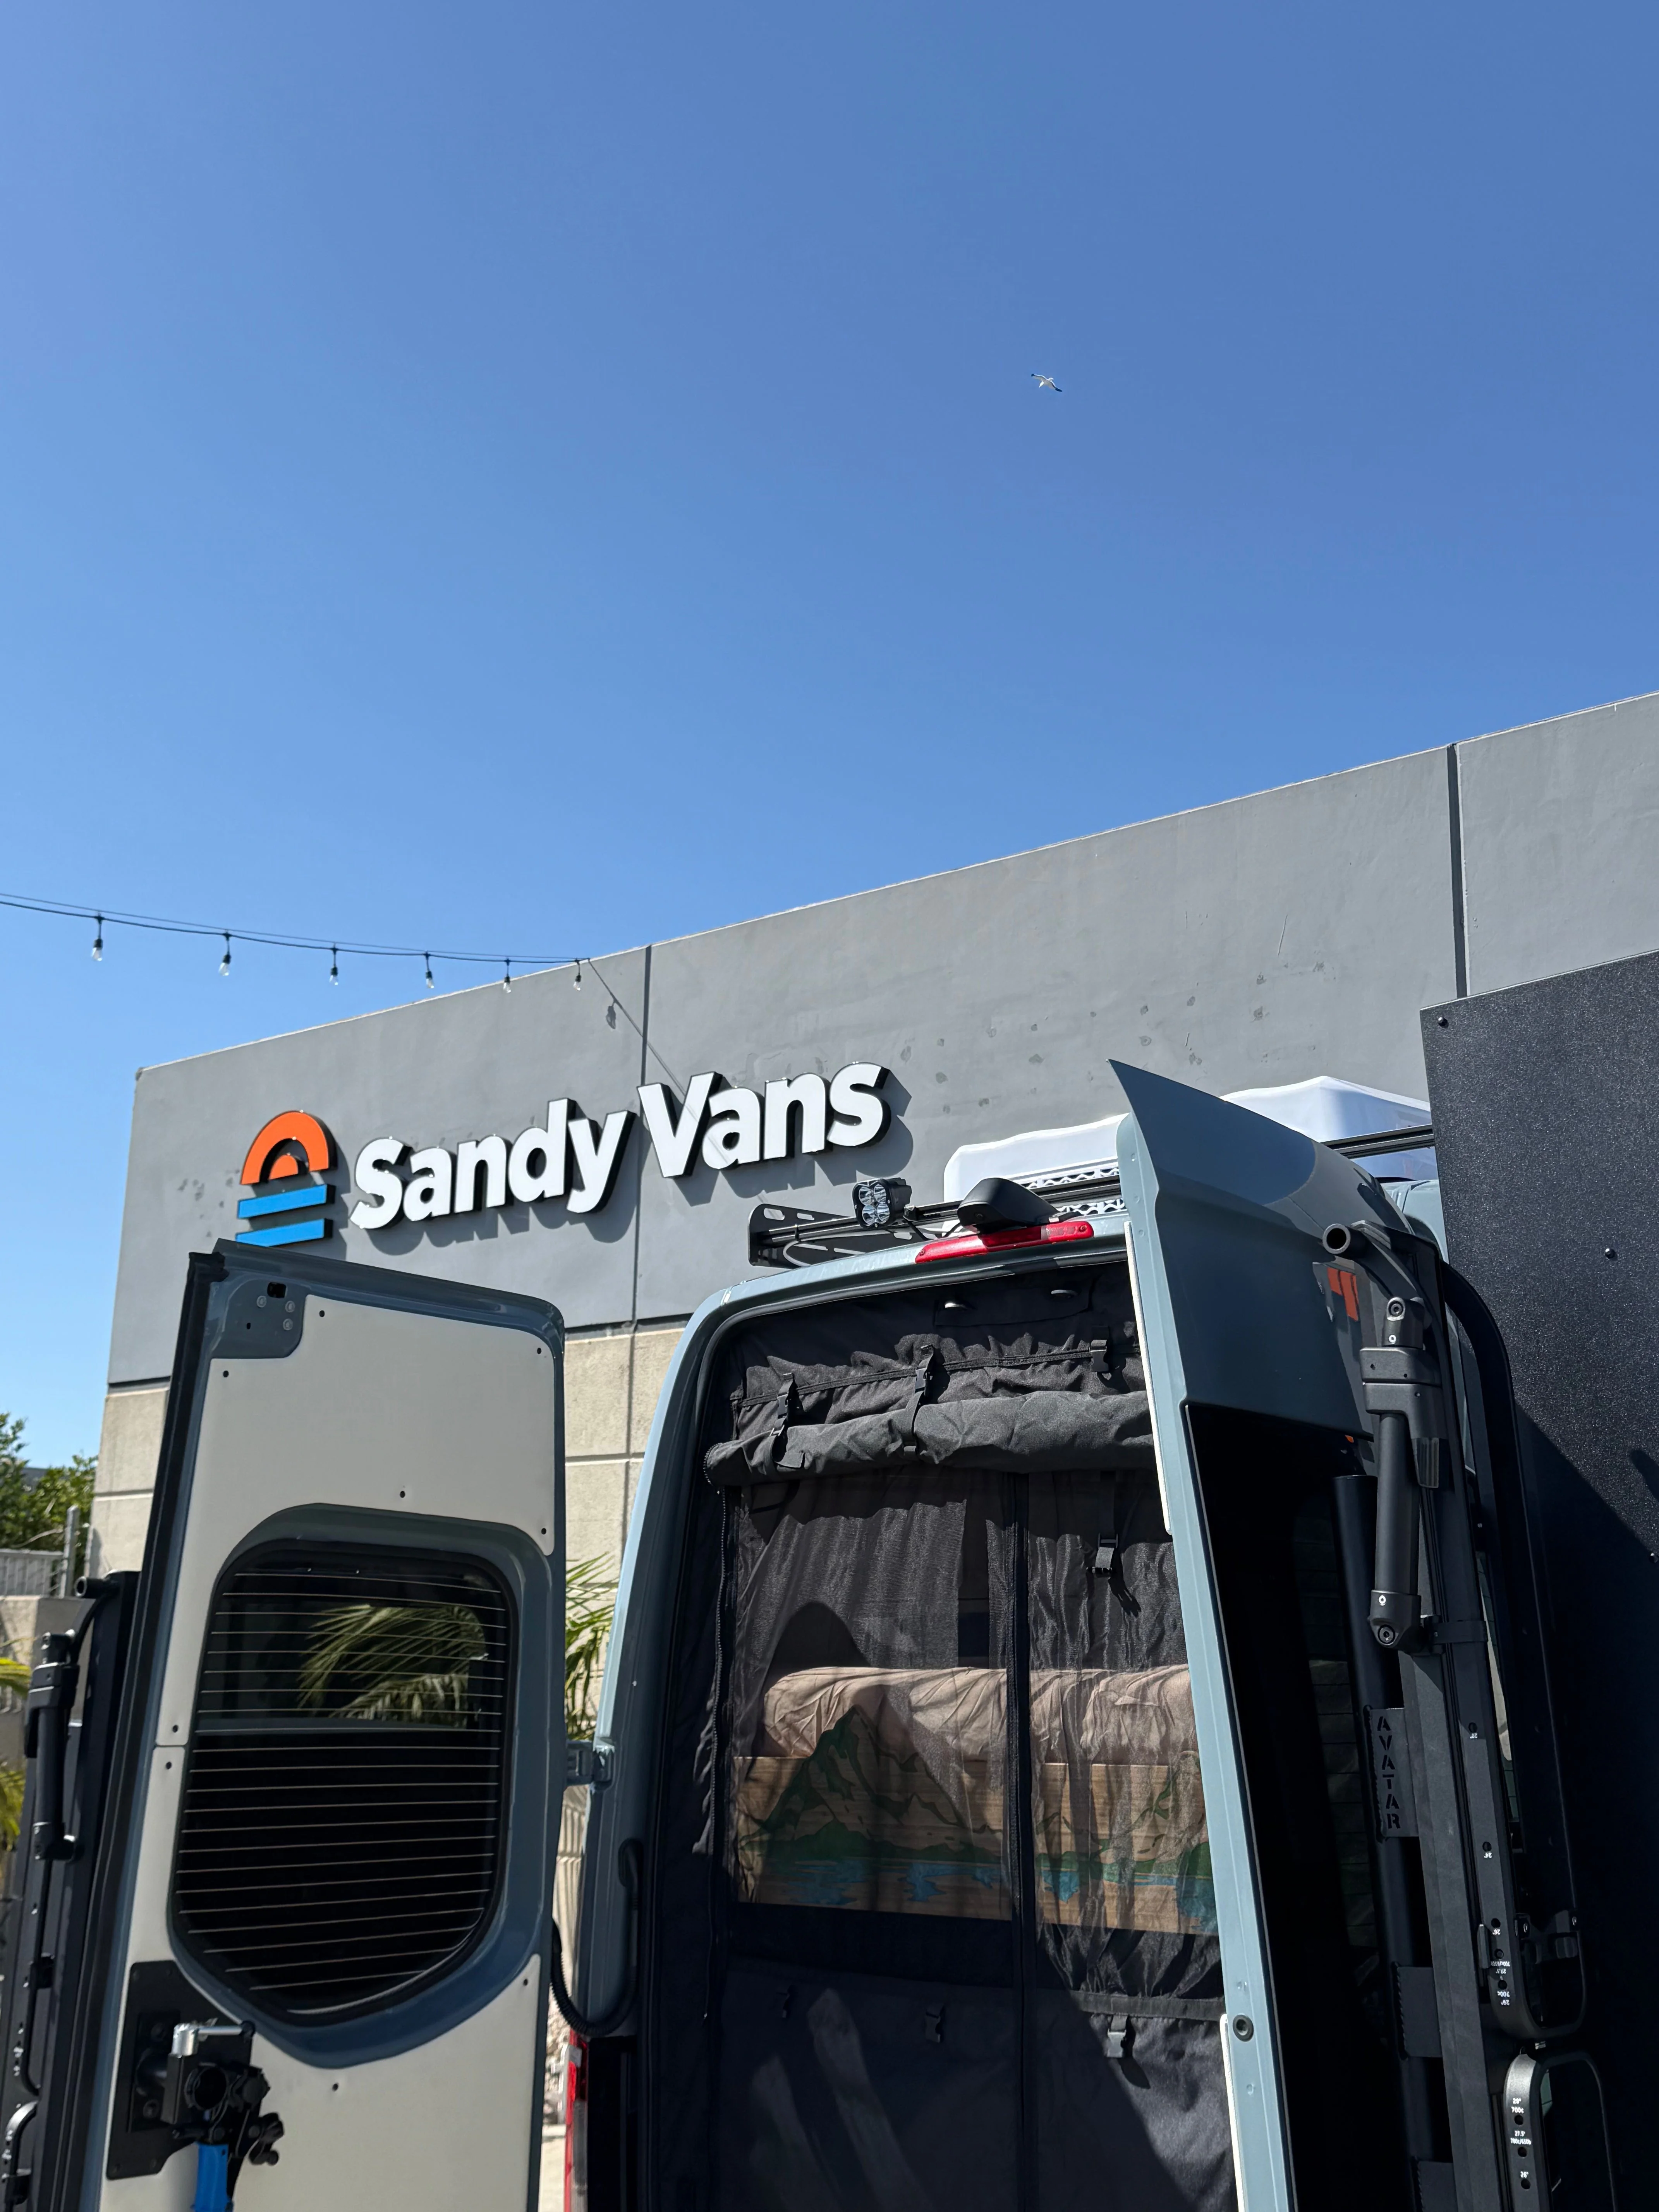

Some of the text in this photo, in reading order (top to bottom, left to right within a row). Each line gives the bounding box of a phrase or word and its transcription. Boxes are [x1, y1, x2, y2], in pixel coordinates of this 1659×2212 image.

[349, 1062, 889, 1229] Sandy Vans
[1377, 1716, 1401, 1829] AVATAR
